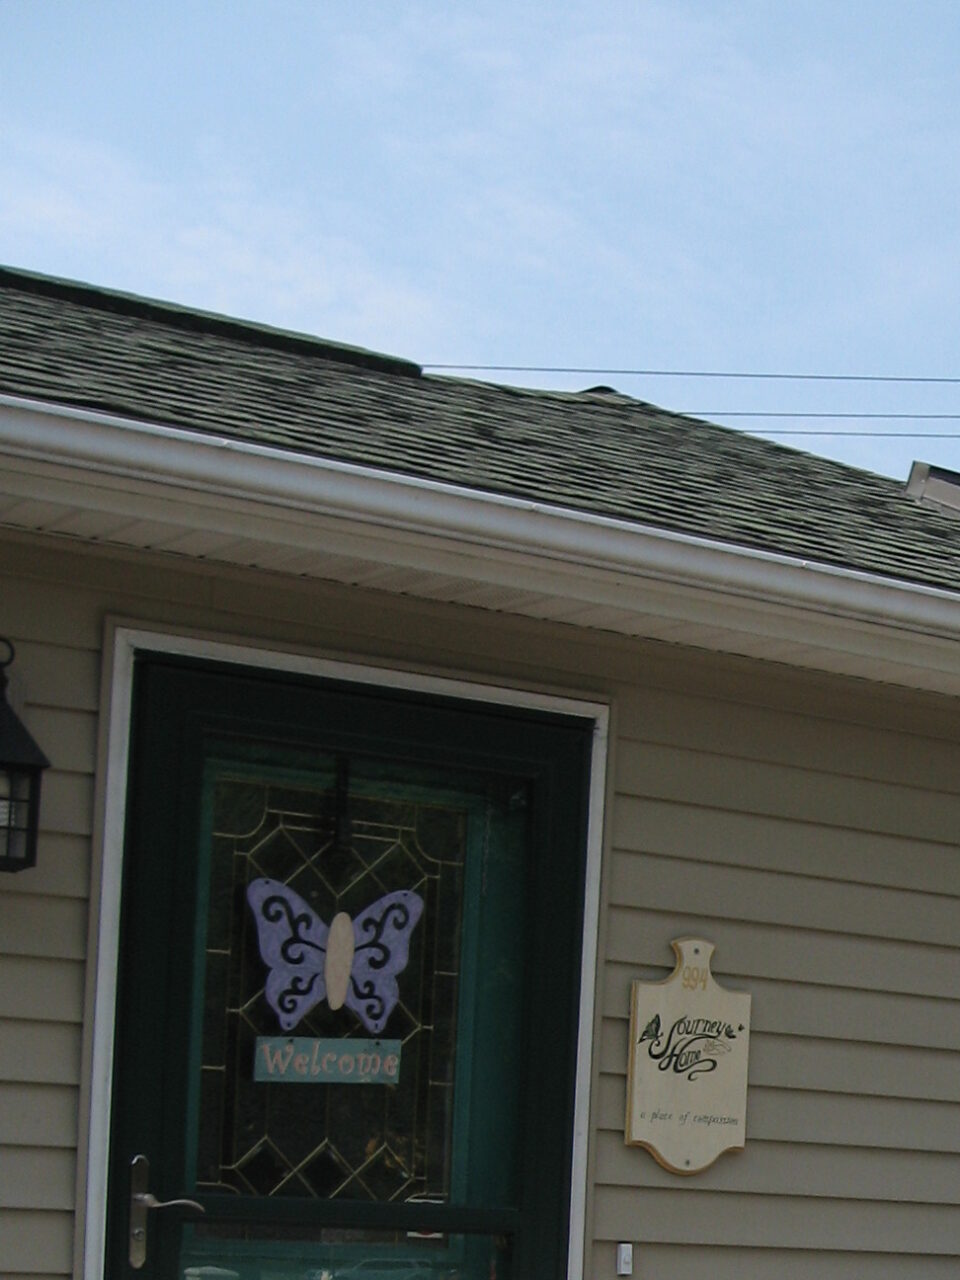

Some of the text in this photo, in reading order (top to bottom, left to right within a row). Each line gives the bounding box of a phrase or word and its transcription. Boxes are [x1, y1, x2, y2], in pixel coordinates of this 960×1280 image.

[682, 966, 708, 990] 994
[648, 1015, 725, 1059] Journey
[261, 1041, 399, 1076] Welcome
[658, 1037, 718, 1081] Home
[650, 1109, 673, 1123] place
[679, 1111, 690, 1126] of
